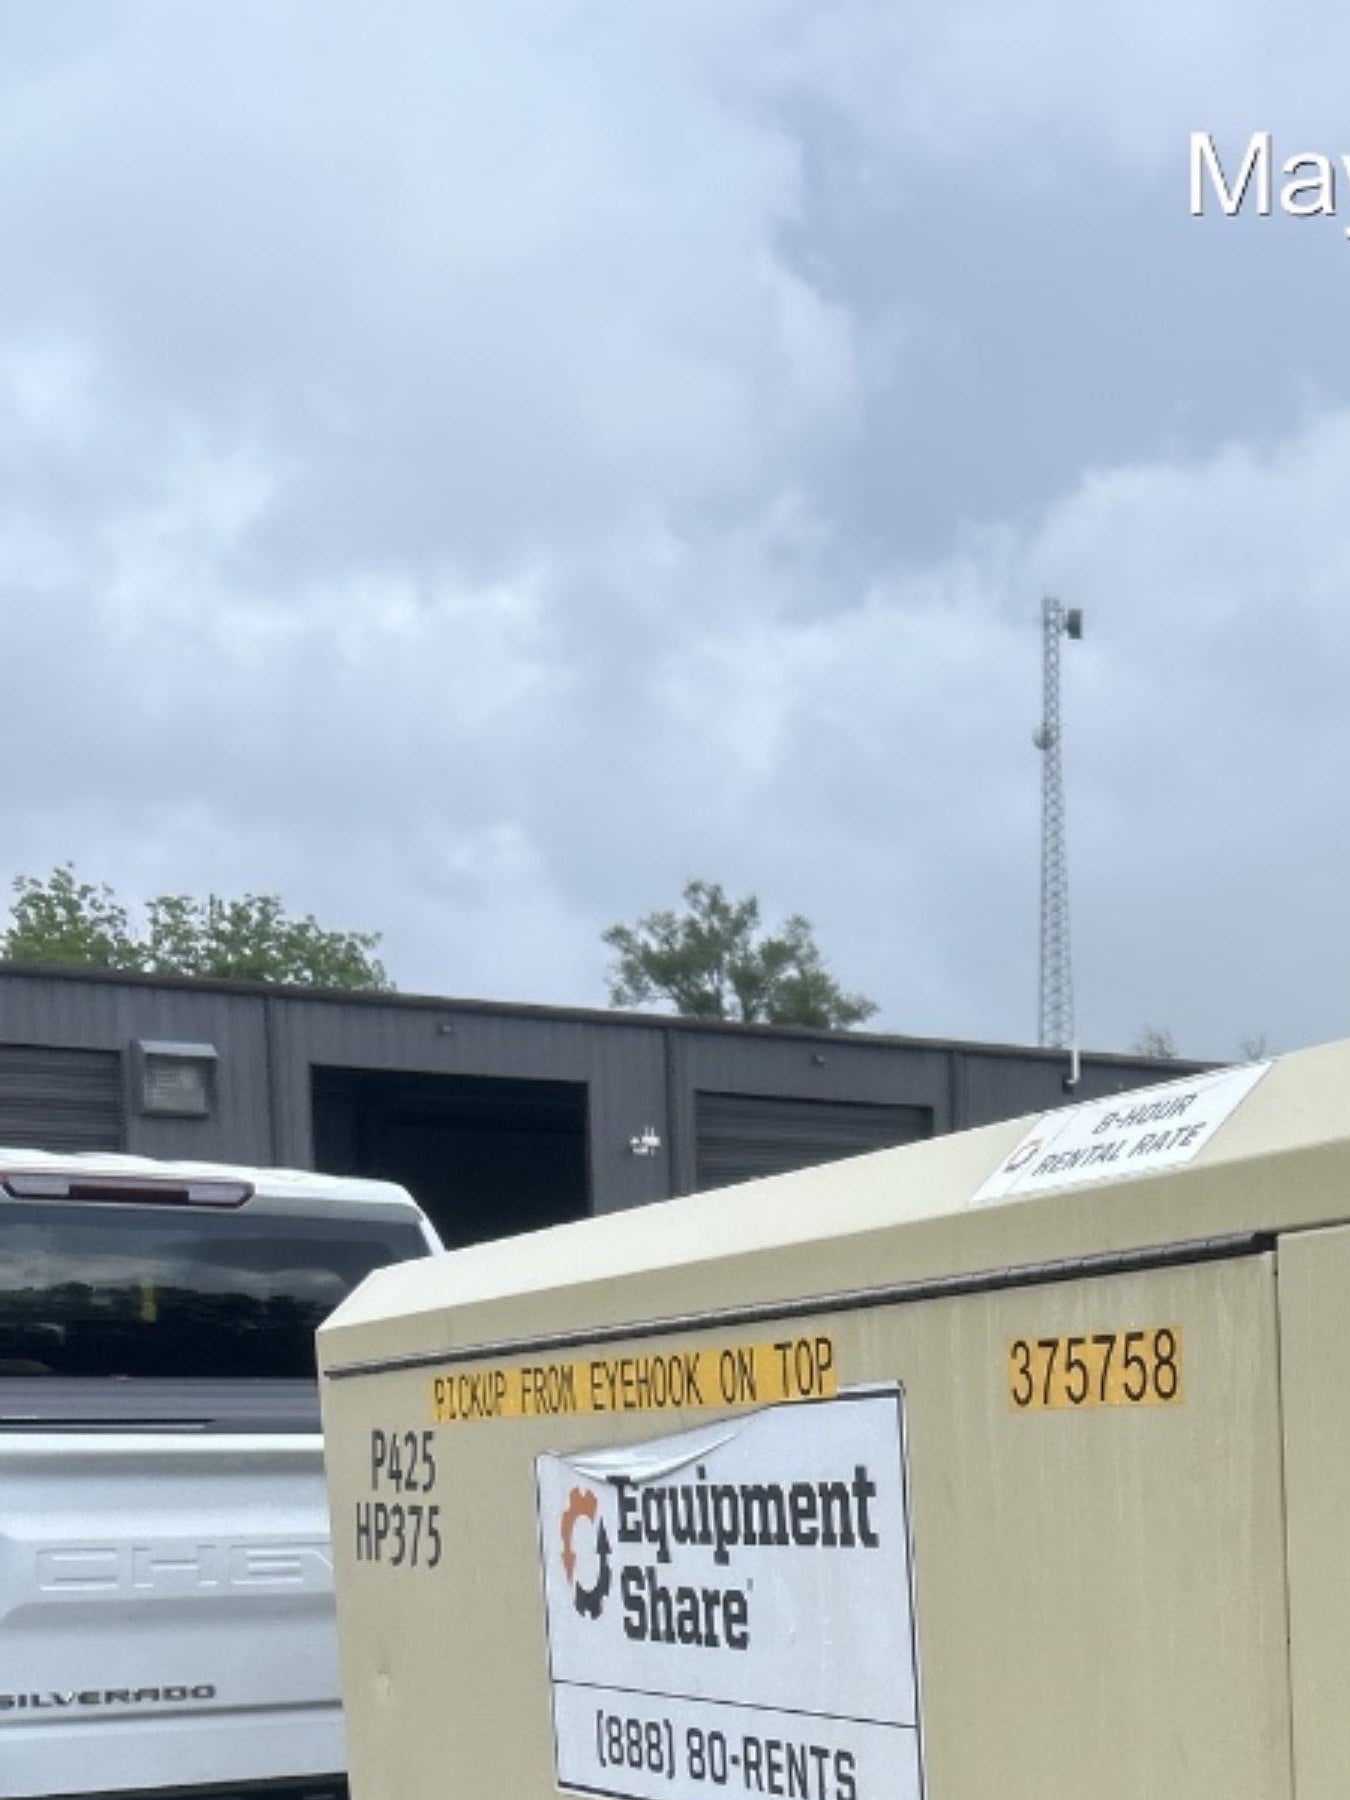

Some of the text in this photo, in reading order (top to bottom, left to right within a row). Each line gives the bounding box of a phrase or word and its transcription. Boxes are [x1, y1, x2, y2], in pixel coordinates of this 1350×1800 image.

[433, 1336, 834, 1420] PICKUP FROM EYEHOOK ON TOP
[1011, 1328, 1179, 1406] 375758
[371, 1430, 436, 1493] P425
[356, 1503, 442, 1567] HP375
[608, 1465, 879, 1564] Equipment
[619, 1565, 750, 1650] Share
[596, 1709, 675, 1780] (888)
